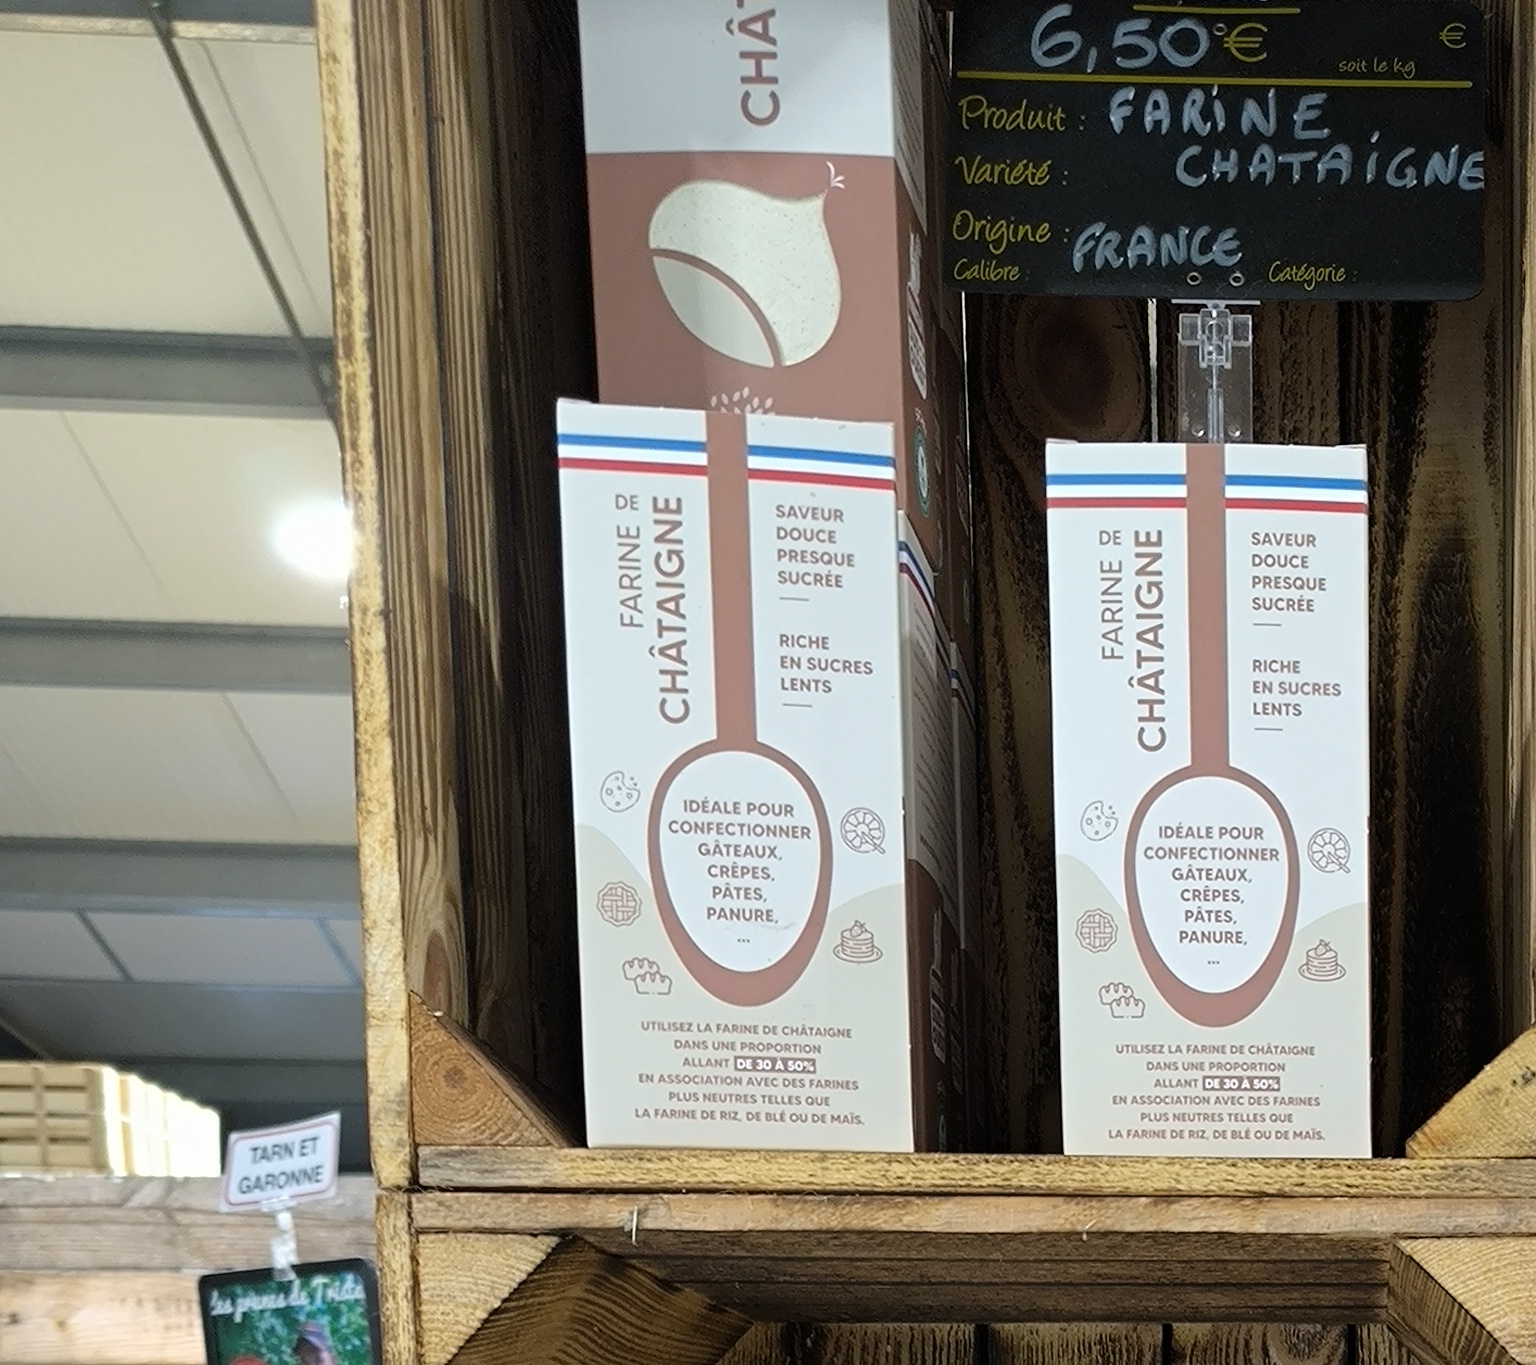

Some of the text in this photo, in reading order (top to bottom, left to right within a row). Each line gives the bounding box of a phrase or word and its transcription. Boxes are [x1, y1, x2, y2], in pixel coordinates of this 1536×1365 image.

[1031, 3, 1268, 74] 6,50 €
[726, 0, 780, 126] CHÂ
[1338, 58, 1416, 80] soit le kg
[958, 95, 1067, 132] Produit
[955, 155, 1051, 187] Variété
[952, 209, 1243, 274] Origine FRANCE
[953, 257, 1347, 291] Calibre Catégorie
[775, 504, 845, 523] SAVEUR
[776, 527, 837, 544] DOUCE
[615, 494, 644, 629] FARINE DE
[776, 548, 856, 568] PRESQUE
[777, 569, 843, 589] SUCRÉE
[649, 496, 690, 724] CHÂTAIGNE
[779, 633, 830, 650] RICHE
[780, 656, 874, 675] EN SUCRES
[780, 678, 832, 694] LENTS
[683, 796, 795, 818] IDÉALE POUR
[668, 821, 812, 840] CONFECTIONNER
[698, 840, 783, 861] GÂTEAUX,
[707, 862, 775, 882] CRÊPES,
[712, 884, 768, 903] PÂTES,
[706, 906, 779, 924] PANURE,
[1115, 1043, 1316, 1057] UTILISEZ LA FARINE DE CHÂTAIGNE
[1146, 1061, 1286, 1073] DANS UNE PROPORTION
[1154, 1075, 1279, 1090] ALLANT DE 30 À 50%
[249, 1136, 319, 1165] TARN ET
[238, 1164, 325, 1195] GARONNE
